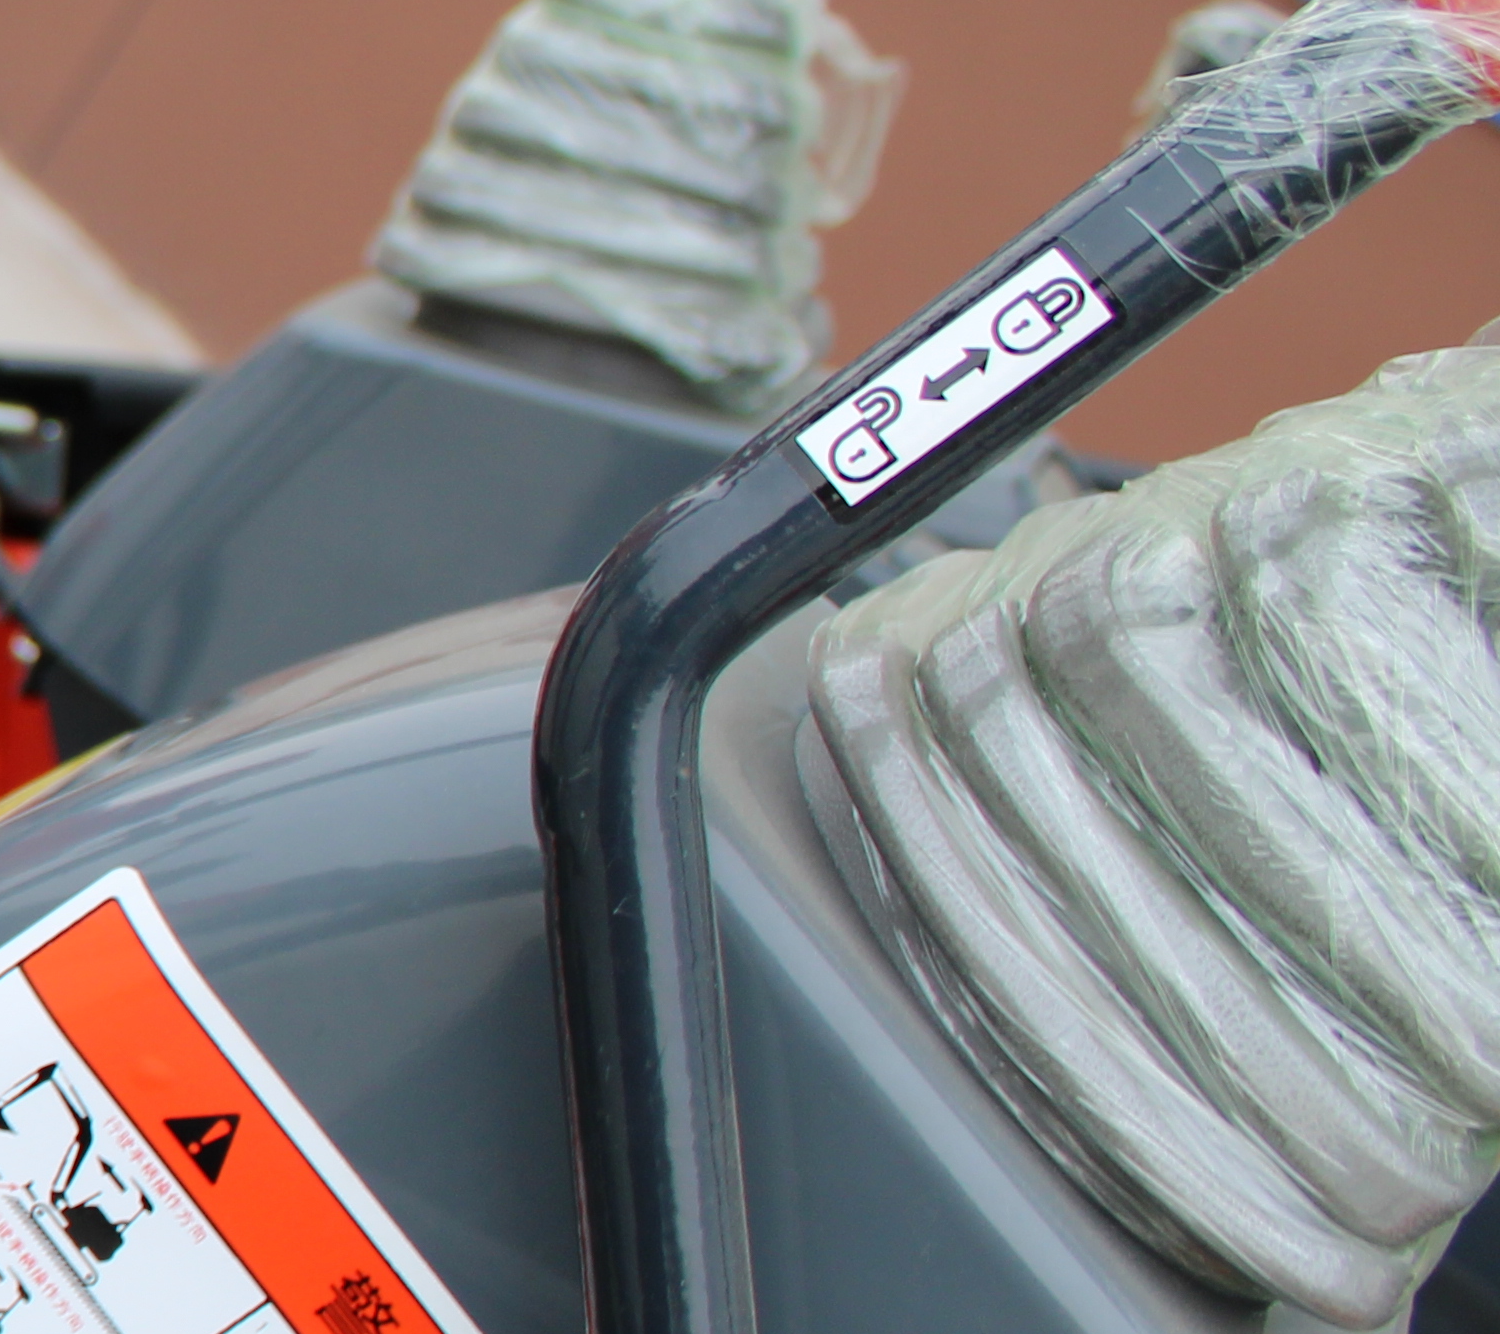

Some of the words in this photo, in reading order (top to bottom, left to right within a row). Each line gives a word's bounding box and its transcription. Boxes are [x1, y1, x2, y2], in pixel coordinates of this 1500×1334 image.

[101, 1113, 210, 1246] 行驶手柄操作方向
